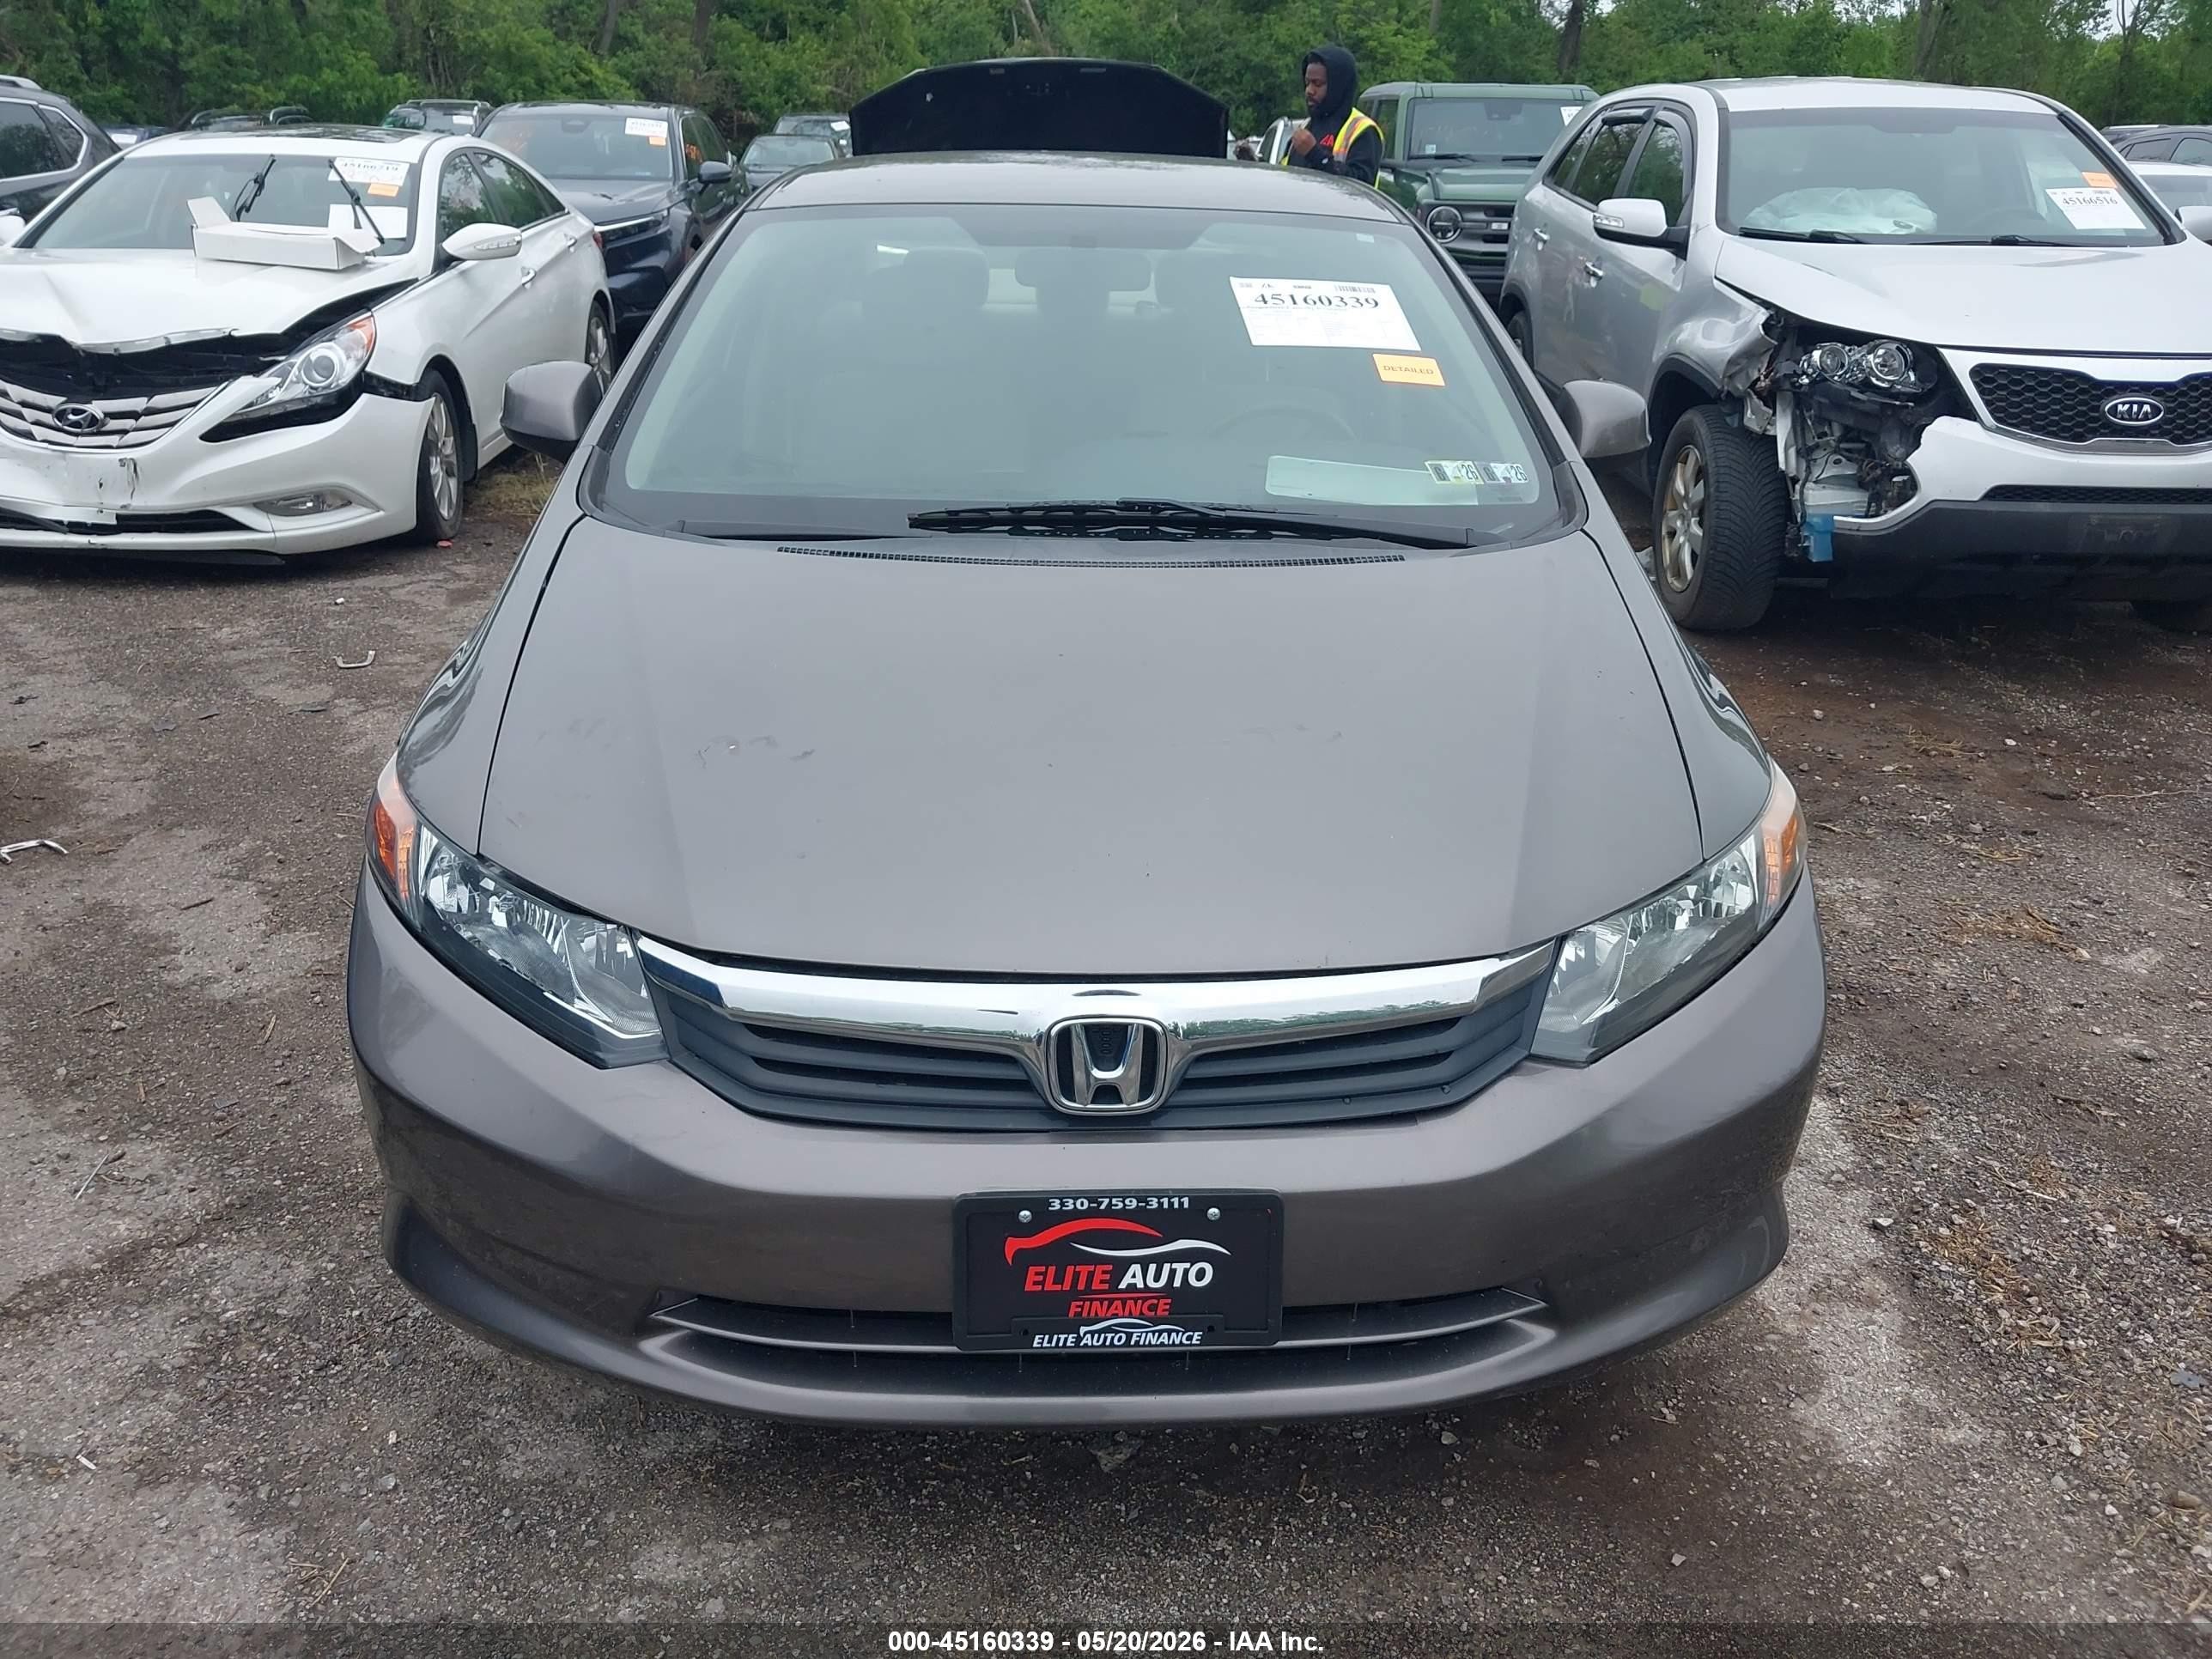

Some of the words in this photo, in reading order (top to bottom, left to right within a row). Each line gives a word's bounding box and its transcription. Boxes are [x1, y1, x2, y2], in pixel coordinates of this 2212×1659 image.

[1255, 294, 1379, 308] 45160339
[1382, 365, 1434, 375] DETAILED
[2117, 404, 2153, 420] KIA
[1462, 464, 1479, 480] 26
[1510, 465, 1528, 481] 26
[1048, 1196, 1190, 1211] 330-759-3111
[1024, 1264, 1113, 1292] ELITE
[1117, 1261, 1214, 1290] AUTO
[1068, 1297, 1172, 1318] FINANCE
[1032, 1333, 1078, 1348] ELITE
[1079, 1332, 1128, 1347] AUTO
[1130, 1330, 1203, 1346] FINANCE
